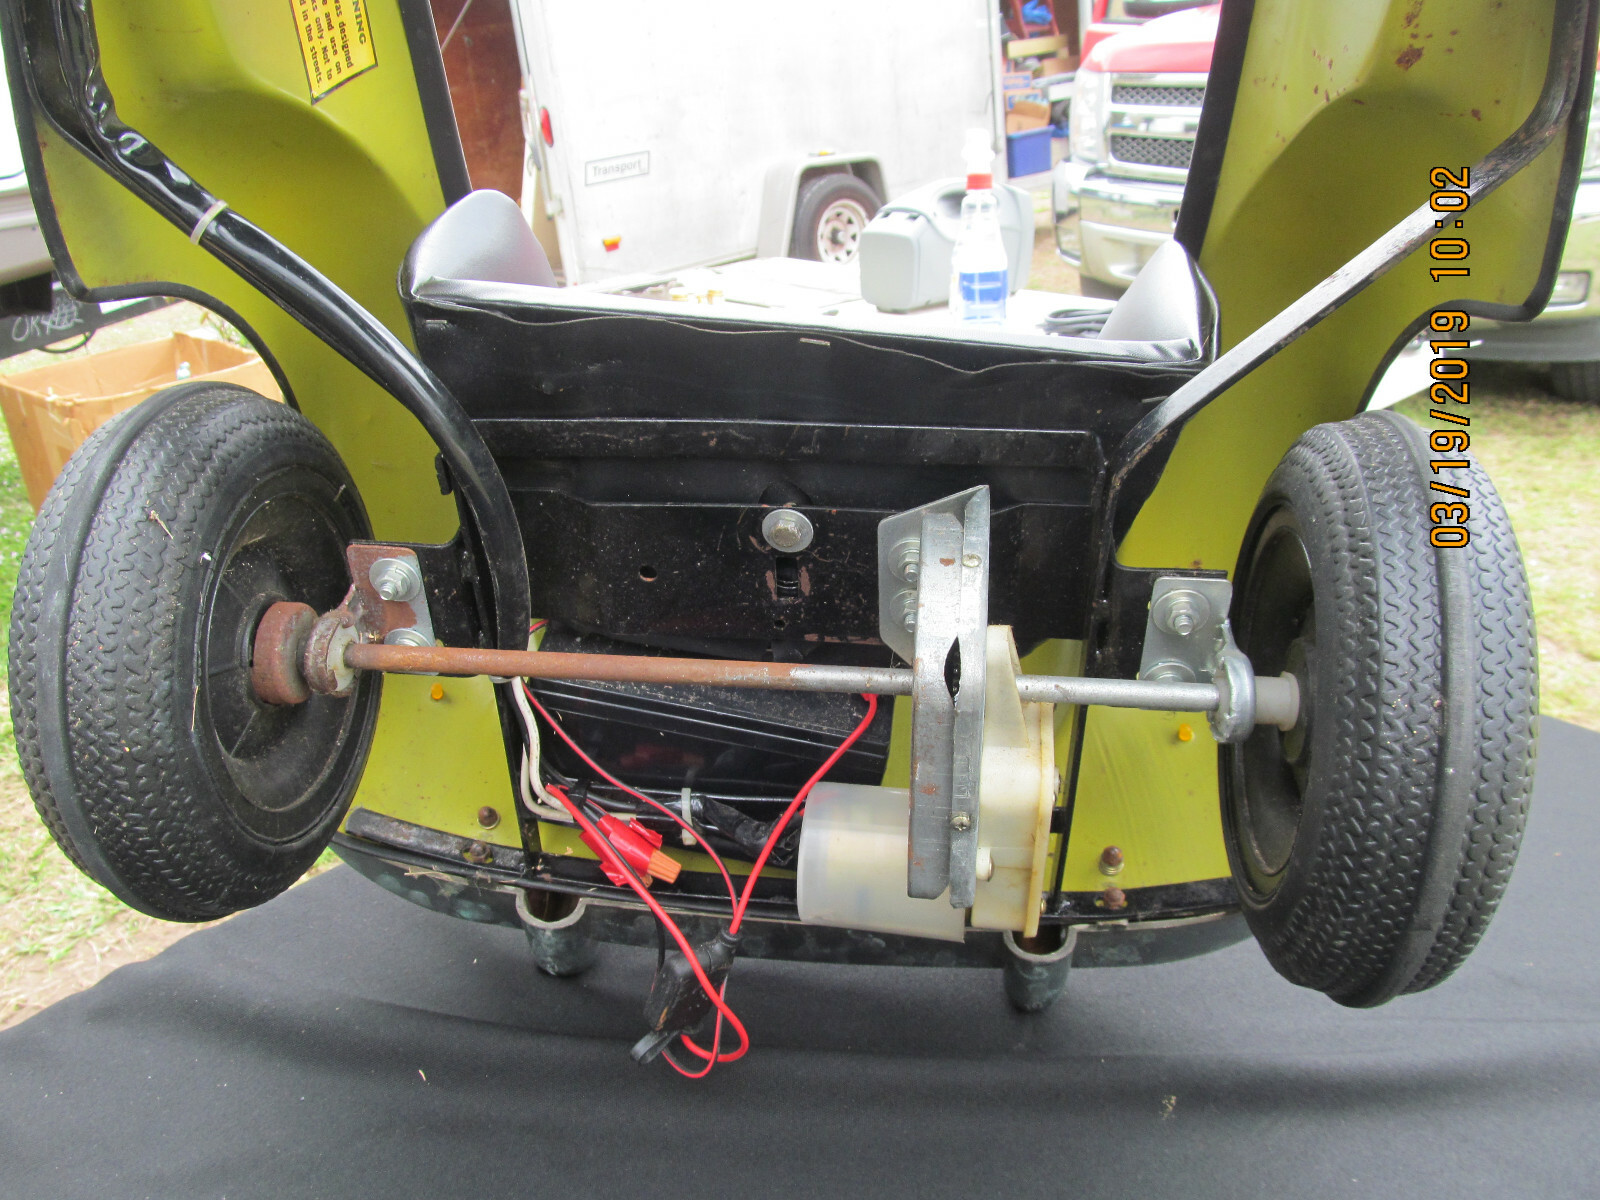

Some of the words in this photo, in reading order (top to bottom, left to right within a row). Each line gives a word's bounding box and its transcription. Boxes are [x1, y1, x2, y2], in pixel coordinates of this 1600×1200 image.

[302, 9, 308, 21] in
[305, 24, 313, 43] the
[310, 45, 322, 88] streets.
[321, 45, 330, 65] Not
[326, 68, 333, 80] to
[325, 12, 335, 31] and
[330, 36, 338, 56] use
[335, 61, 342, 74] on
[338, 21, 354, 68] designed
[592, 158, 641, 177] Transport
